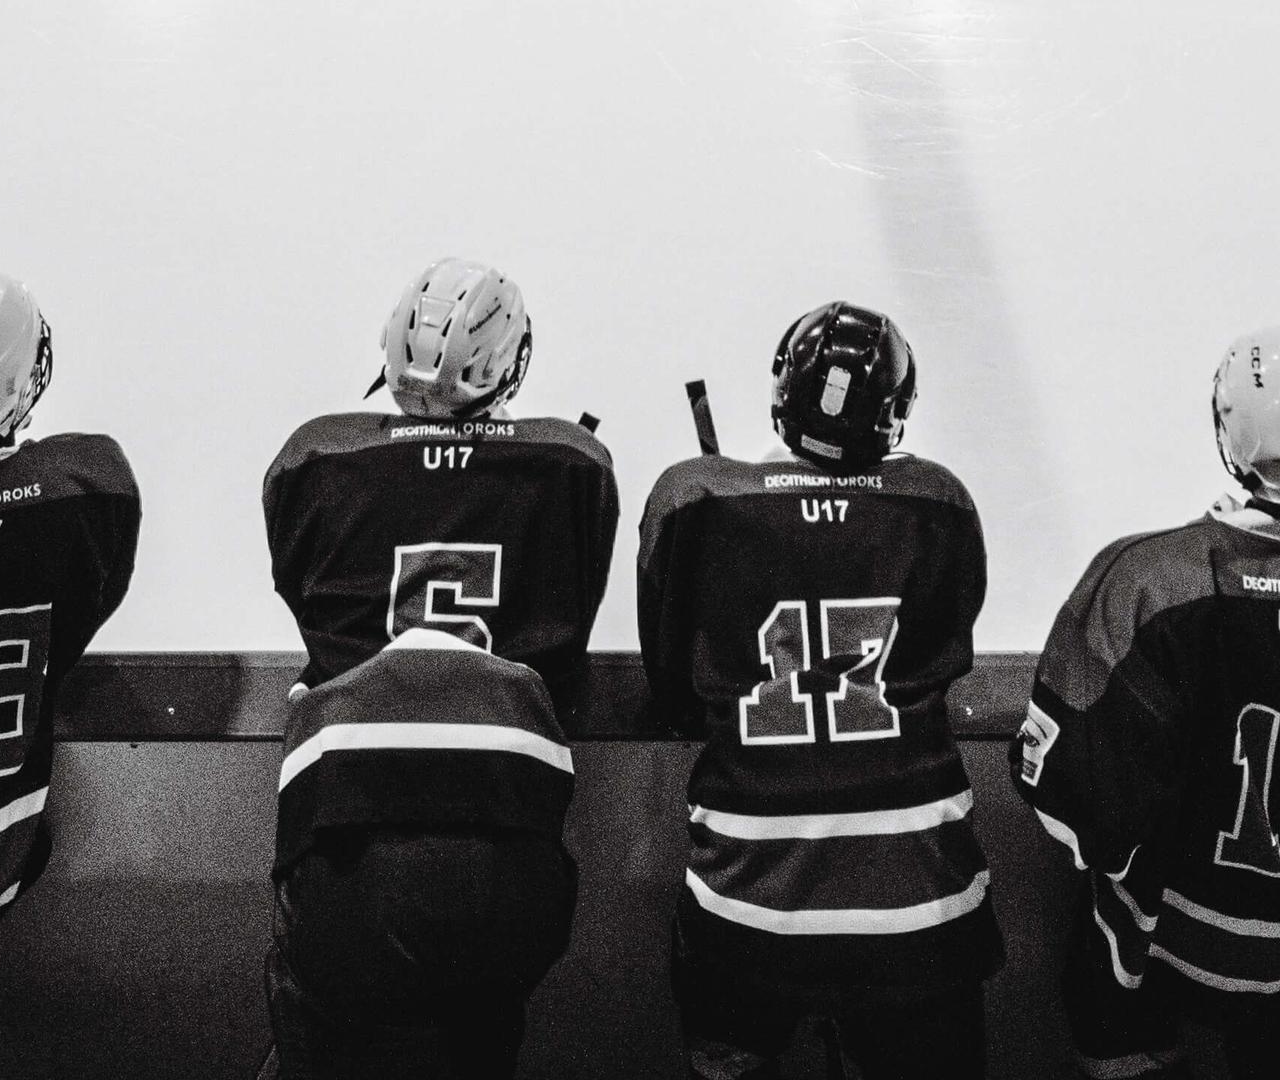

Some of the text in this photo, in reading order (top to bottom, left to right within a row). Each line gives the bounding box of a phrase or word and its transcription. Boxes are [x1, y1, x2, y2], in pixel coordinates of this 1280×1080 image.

[1250, 346, 1264, 389] CCM
[463, 421, 515, 437] OROKS
[423, 446, 474, 470] U17
[801, 499, 849, 522] U17
[738, 596, 902, 746] 17
